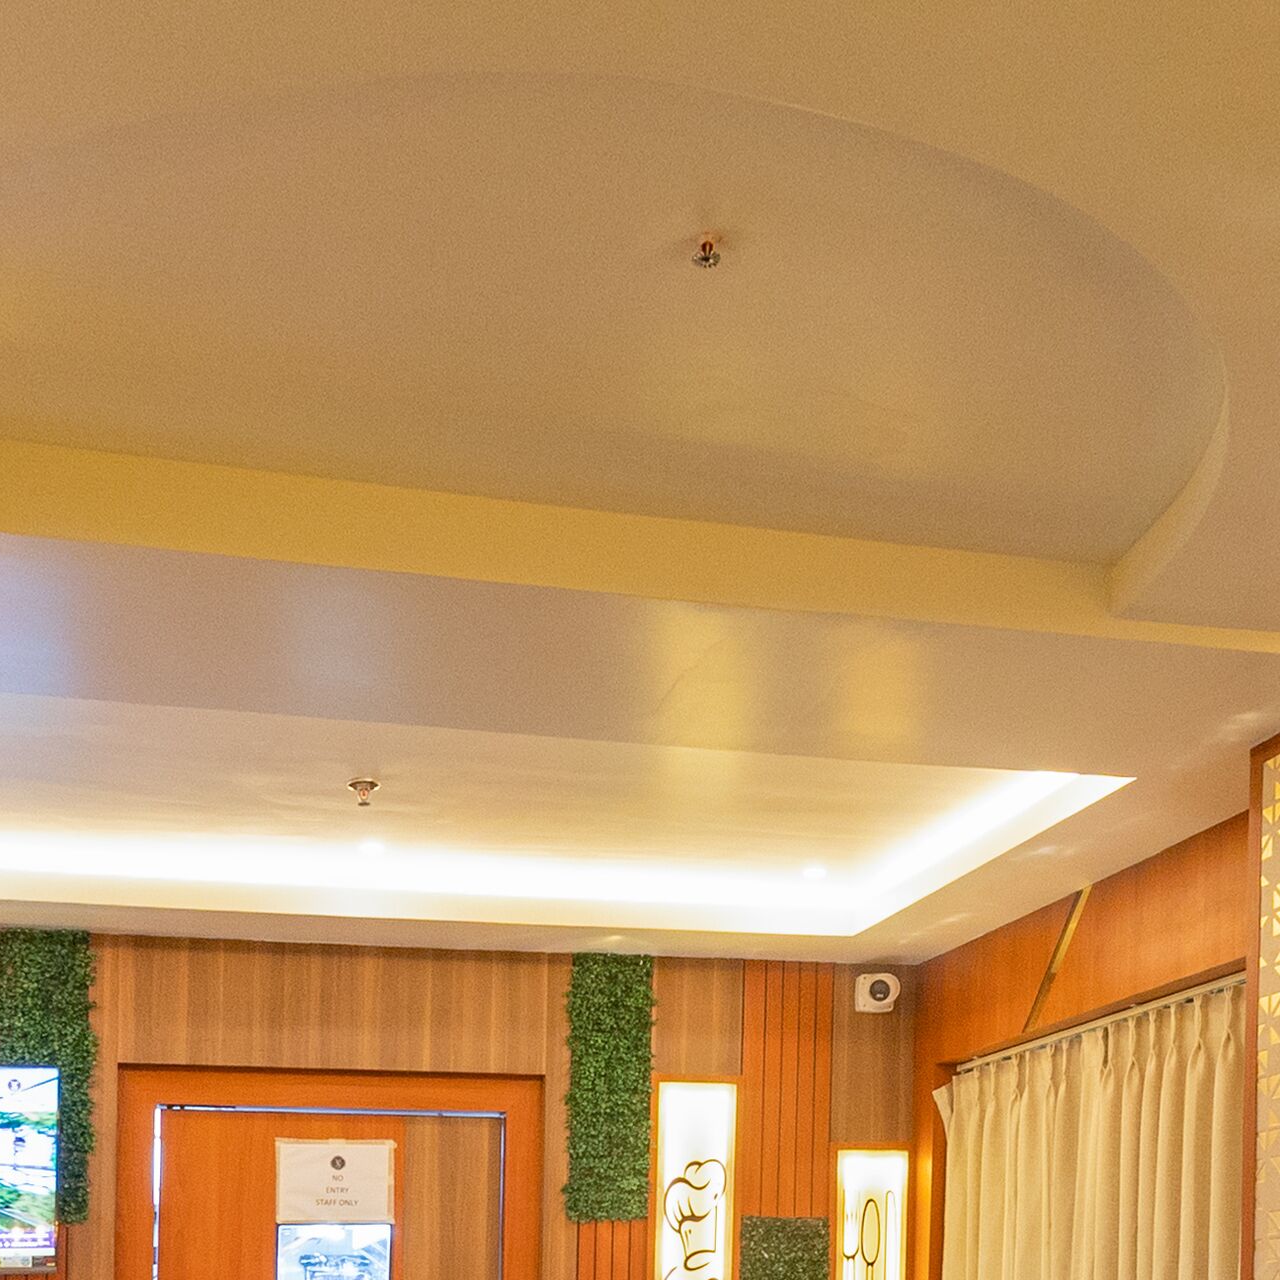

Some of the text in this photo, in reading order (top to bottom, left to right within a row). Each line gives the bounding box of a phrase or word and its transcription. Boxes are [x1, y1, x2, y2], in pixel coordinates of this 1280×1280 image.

[332, 1174, 344, 1182] NO
[326, 1186, 349, 1194] ENTRY
[315, 1198, 359, 1206] STAFF ONLY
